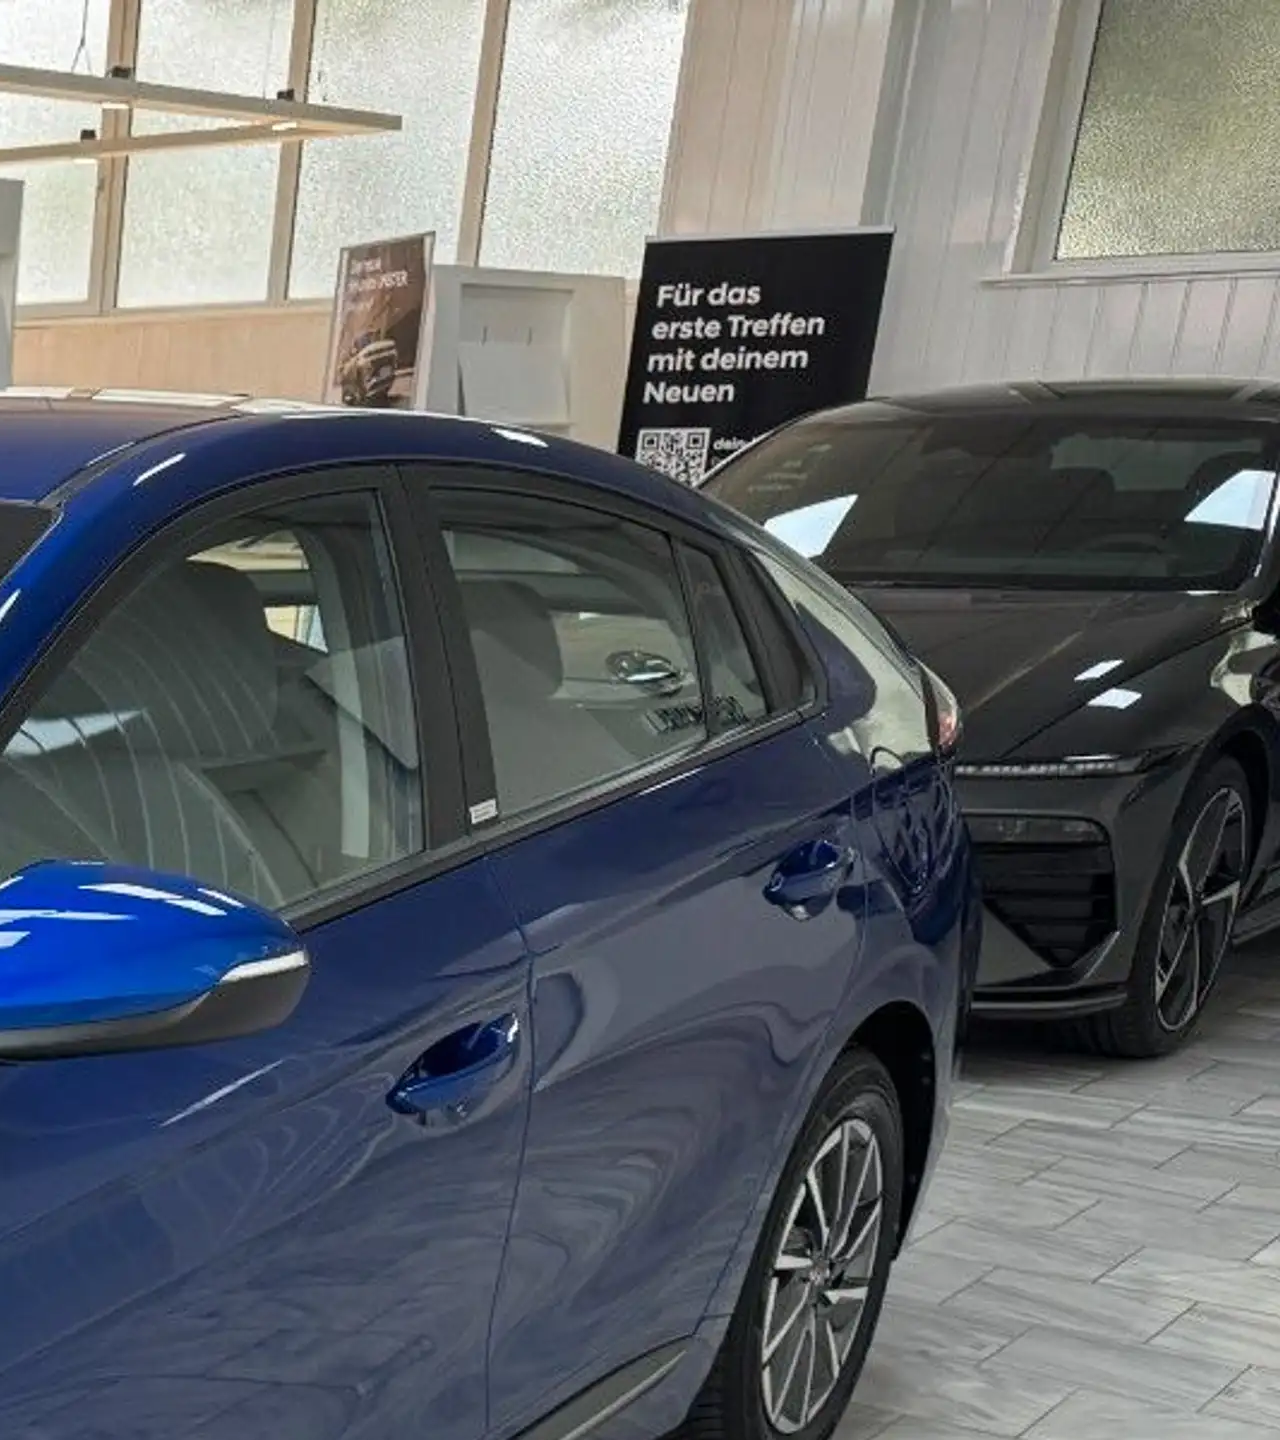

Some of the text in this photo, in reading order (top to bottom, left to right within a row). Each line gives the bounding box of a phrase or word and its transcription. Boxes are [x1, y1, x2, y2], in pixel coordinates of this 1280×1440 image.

[657, 281, 761, 307] Für das
[651, 312, 825, 340] erste Treffen
[647, 347, 808, 373] mit deinem
[643, 381, 735, 404] Neuen
